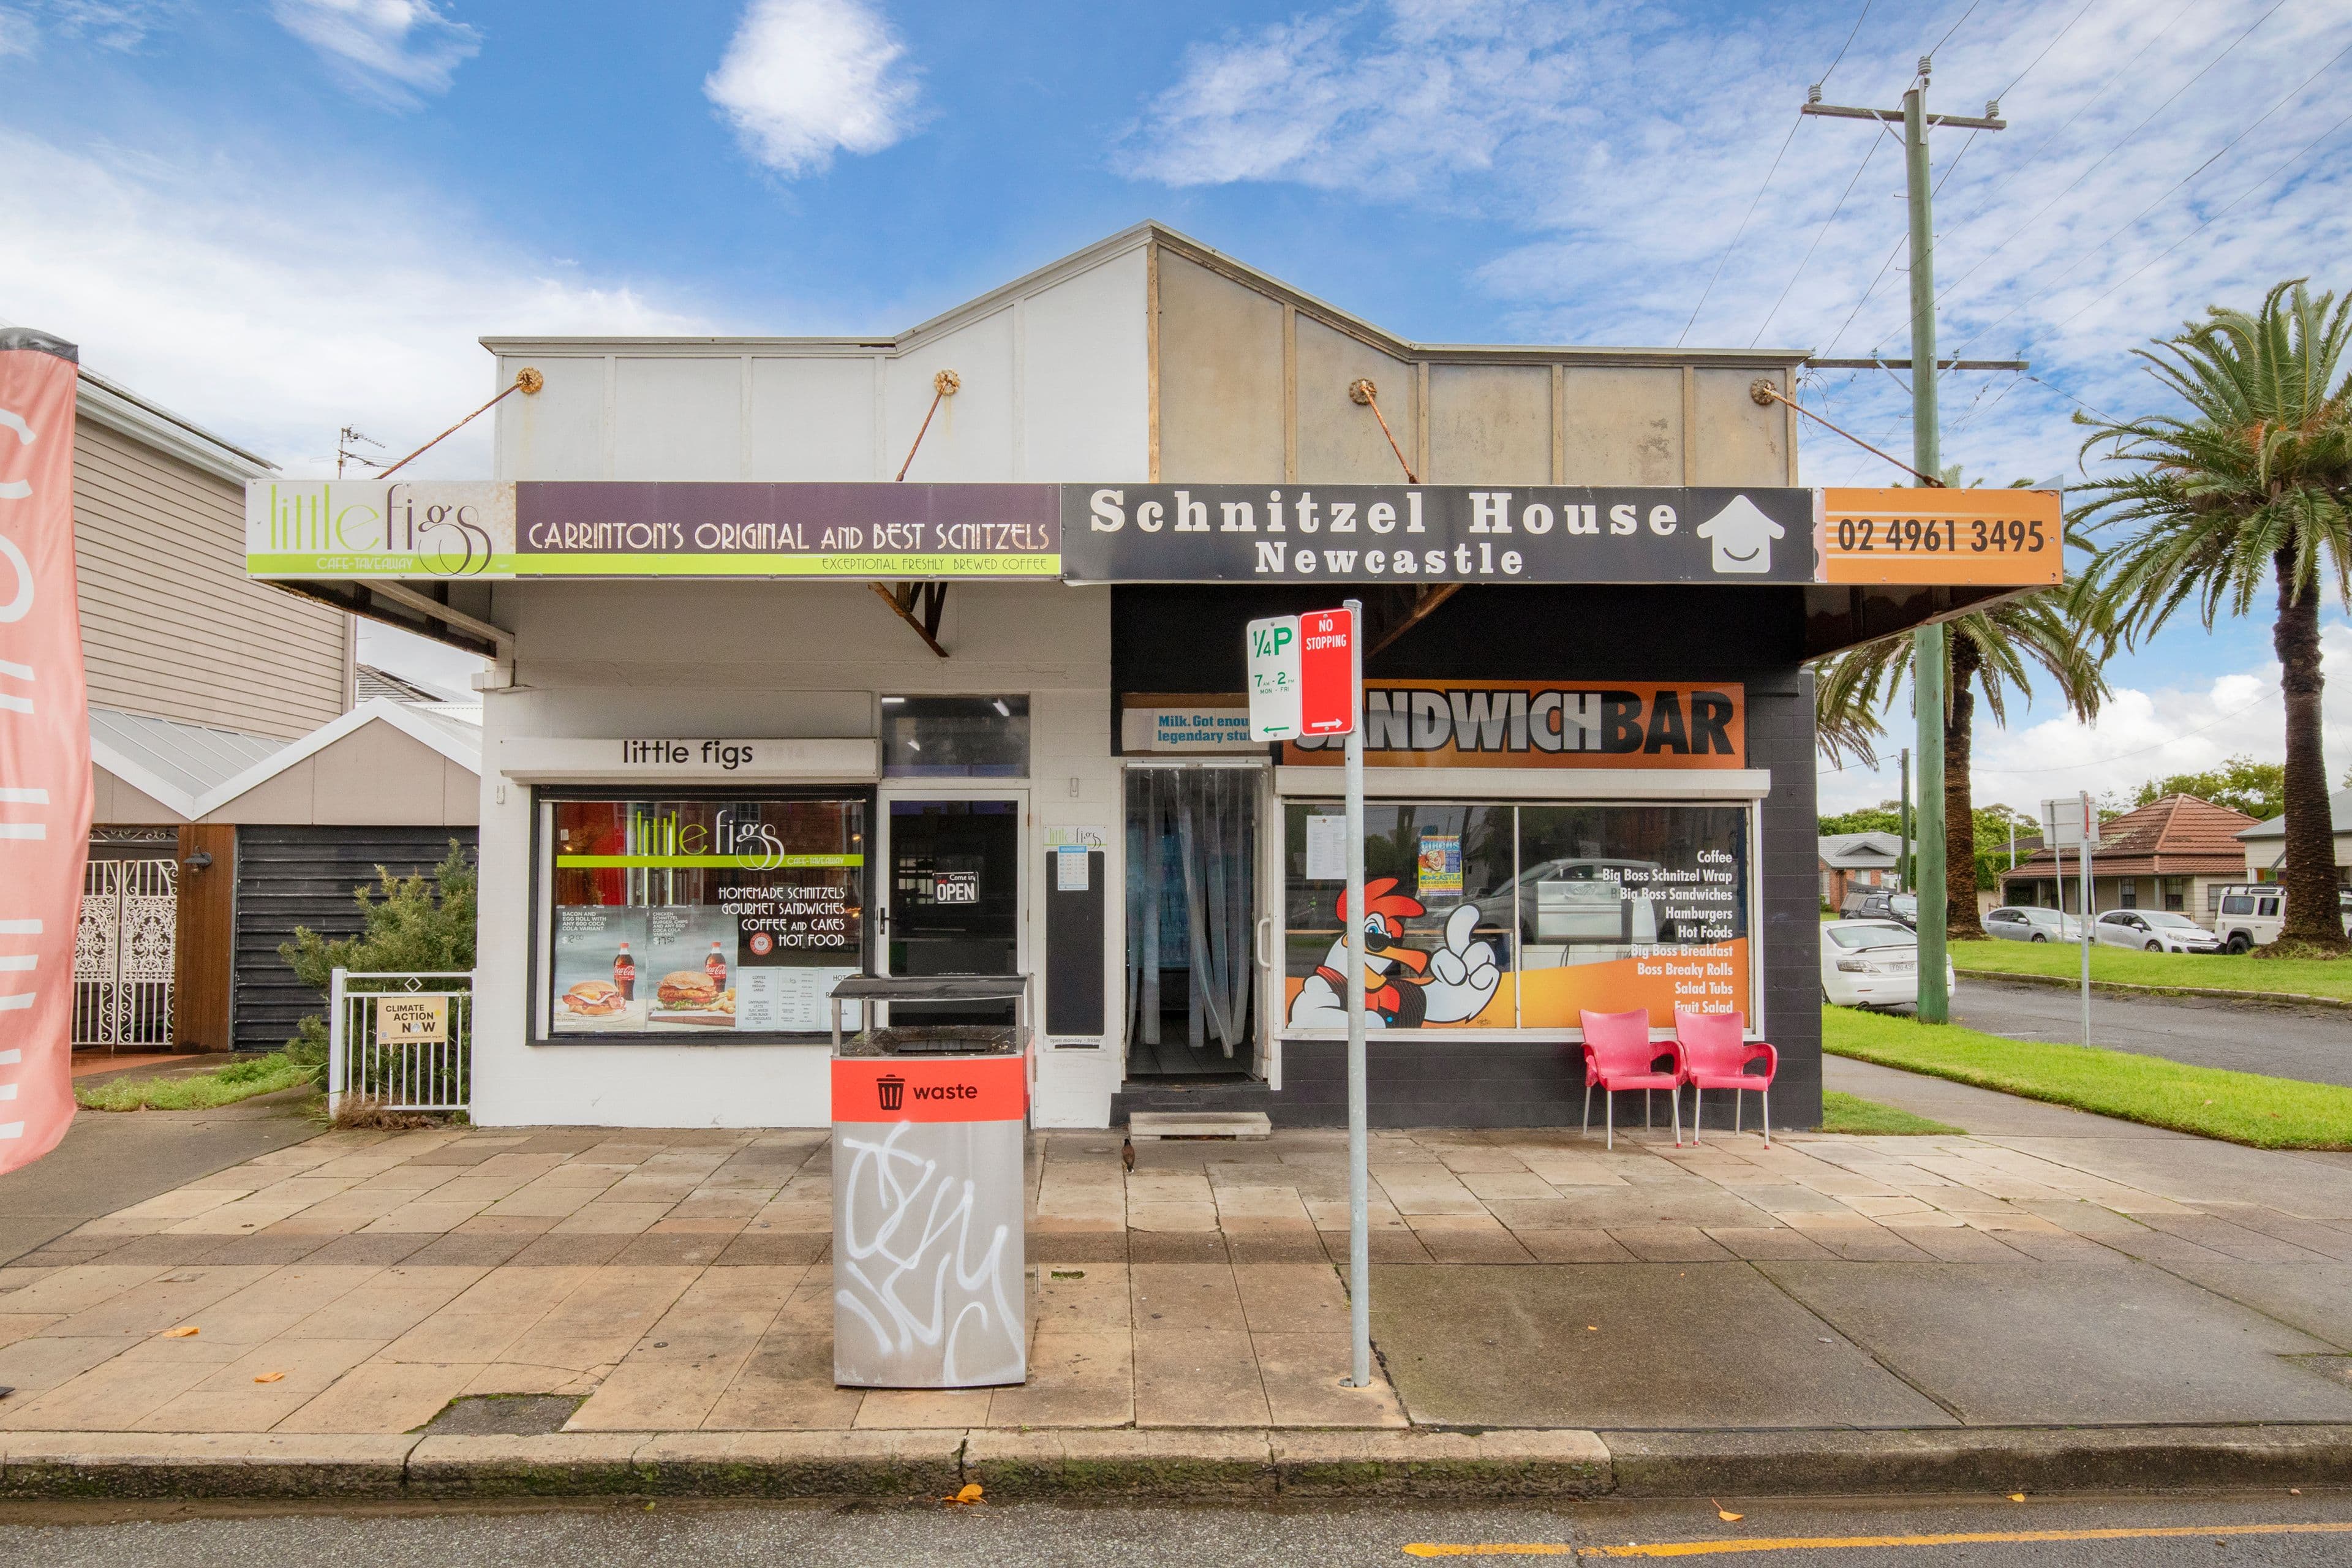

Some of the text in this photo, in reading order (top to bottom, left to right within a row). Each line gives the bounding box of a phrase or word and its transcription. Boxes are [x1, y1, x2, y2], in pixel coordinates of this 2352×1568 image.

[1090, 489, 1678, 535] Schnitzel House
[529, 522, 1050, 551] CARRINTON'S ORIGINAL AND BEST SCNITZELS
[1838, 518, 2045, 552] 02 4961 3495
[822, 557, 1048, 571] EXCEPTIONAL FRESHLY BREWED COFFEE
[1254, 540, 1525, 575] Newcastle
[1319, 619, 1333, 633] NO
[1306, 633, 1347, 650] STOPPING
[1158, 715, 1250, 727] Milk. Got enou
[1296, 690, 1601, 751] NDWICH
[1158, 729, 1223, 744] legendary
[623, 740, 753, 770] little figs
[637, 809, 785, 871] little figs
[1421, 841, 1460, 850] CIRCUS
[1697, 850, 1733, 863] Coffee
[1602, 868, 1733, 883] Big Boss Schnitzel Wrap
[718, 886, 845, 899] HOMEMADE SCHNITZELS
[937, 882, 975, 901] OPEN
[1620, 887, 1733, 903] Big Boss Sandwiches
[722, 902, 845, 915] GOURMET SANDWICHES
[1665, 906, 1733, 922] Hamburgers
[741, 918, 845, 931] COFFEE AND CAKES
[1678, 925, 1733, 938] Hot Foods
[778, 933, 804, 946] HOT
[807, 933, 845, 946] FOOD
[1631, 943, 1733, 959] Big Boss Breakfast
[1637, 962, 1733, 978] Boss Breaky Rolls
[1675, 981, 1733, 995] Salad Tubs
[385, 1004, 425, 1012] CLIMATE
[1675, 1000, 1733, 1013] Fruit Salad
[393, 1012, 434, 1021] ACTION
[913, 1083, 978, 1100] waste
